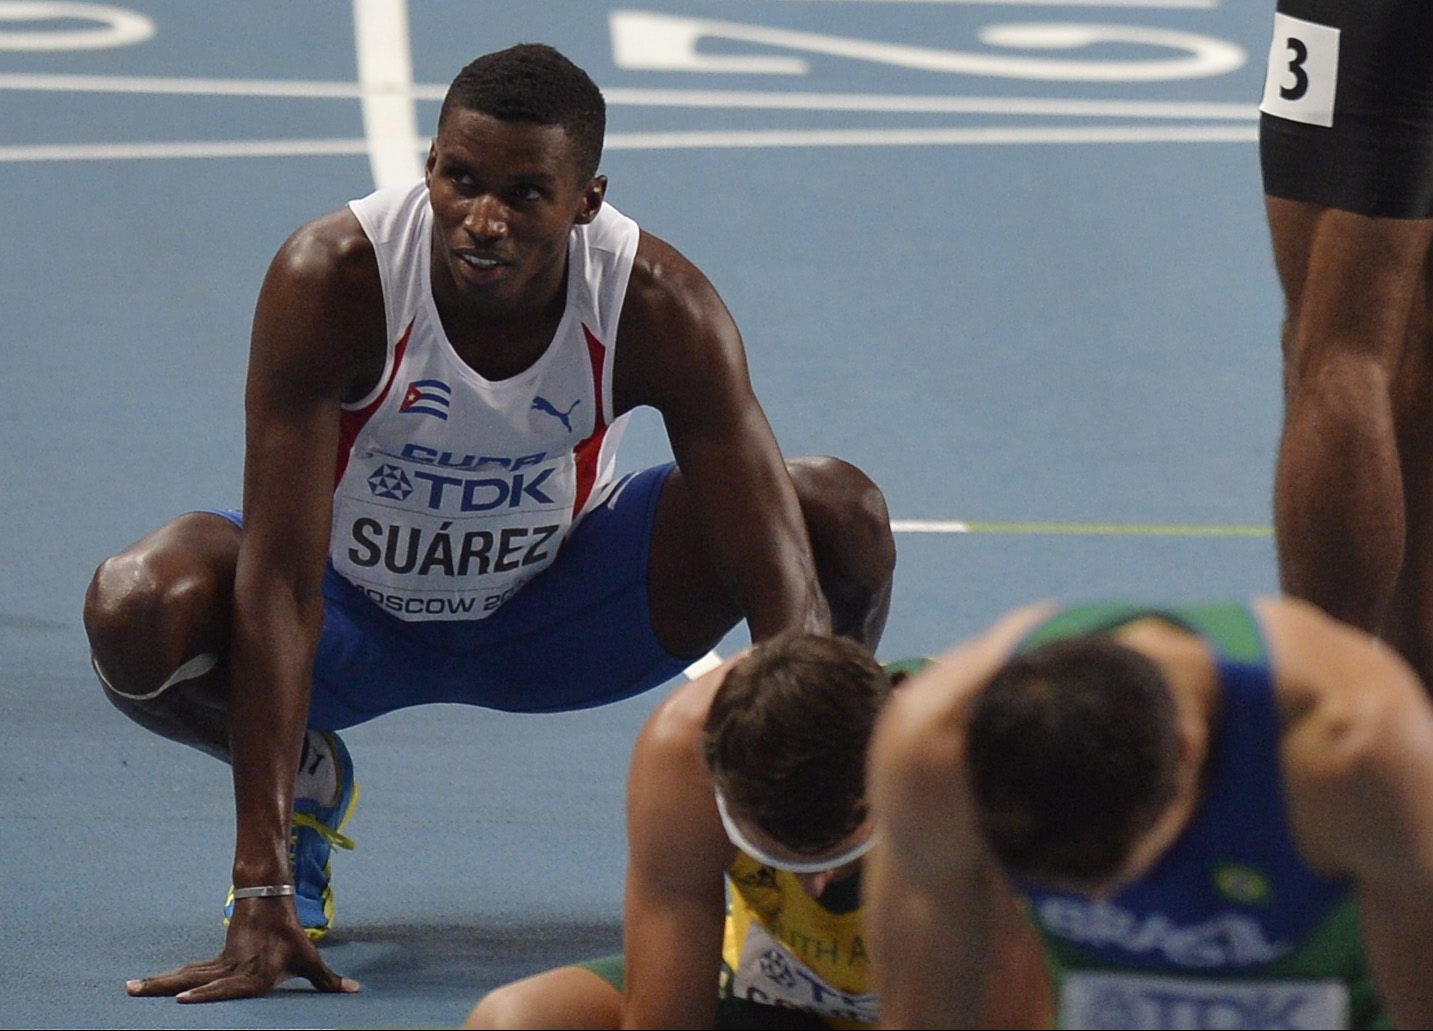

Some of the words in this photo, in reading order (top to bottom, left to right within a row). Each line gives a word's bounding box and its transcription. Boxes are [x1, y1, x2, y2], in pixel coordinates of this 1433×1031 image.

[1279, 37, 1309, 101] 3
[414, 467, 557, 512] TDK
[348, 517, 559, 577] SUÁREZ
